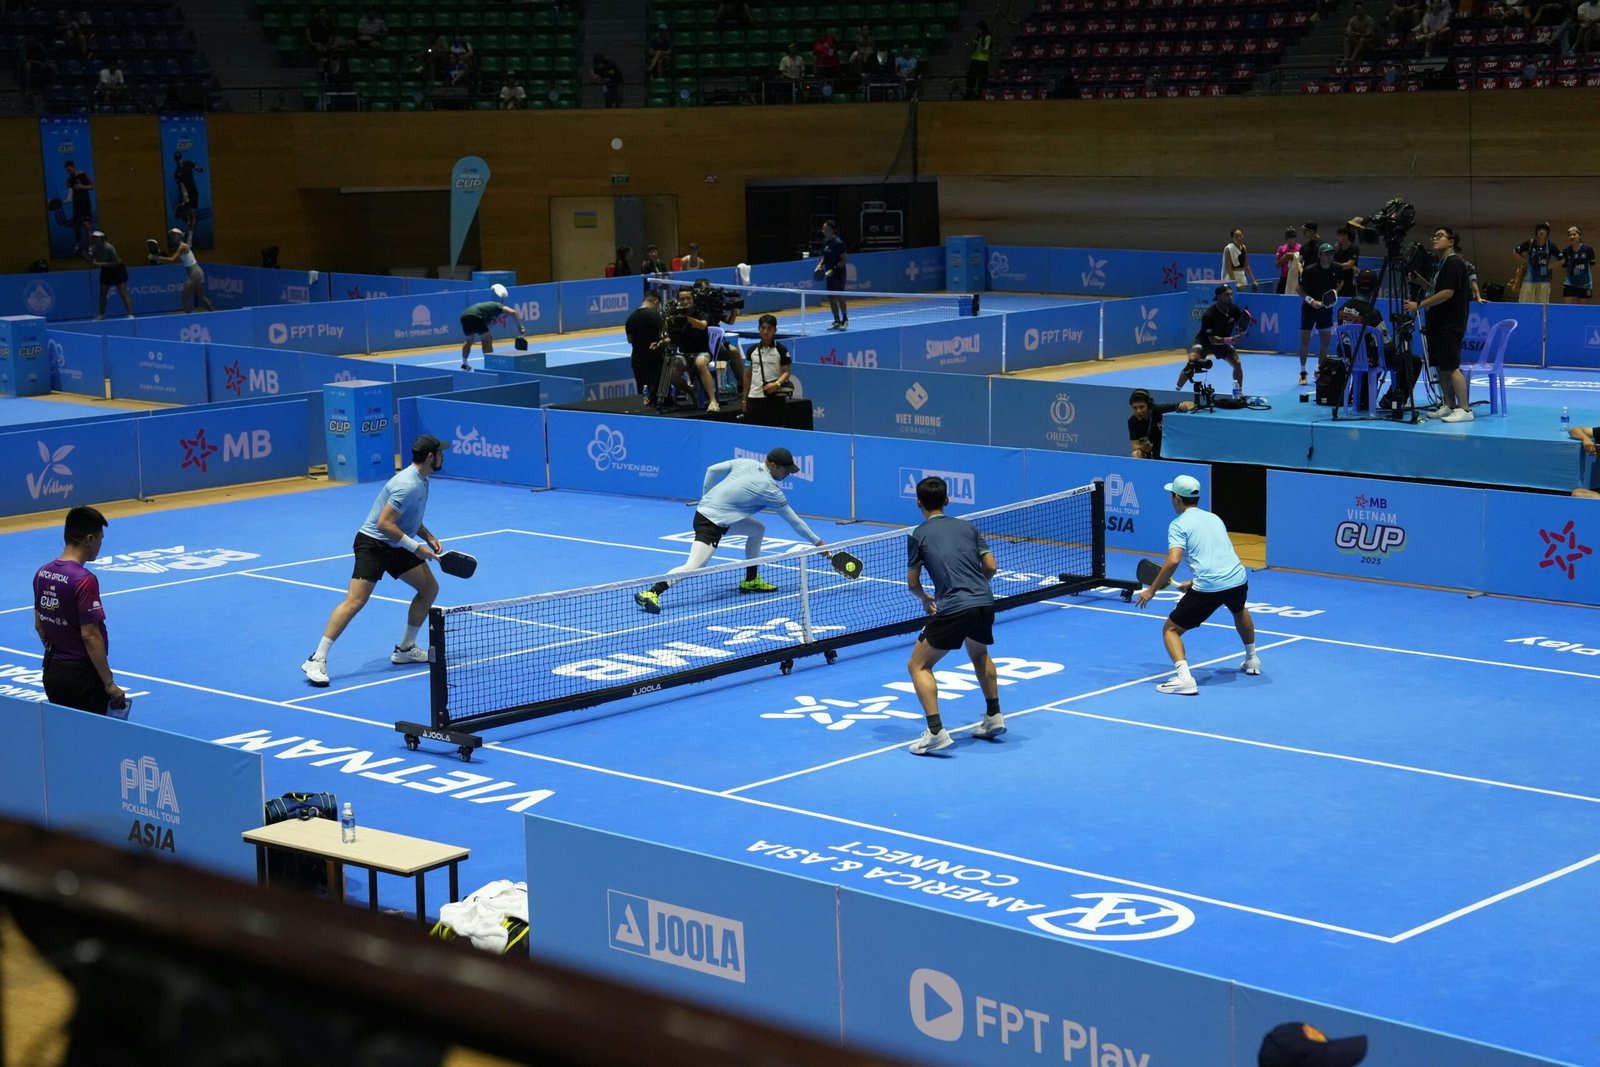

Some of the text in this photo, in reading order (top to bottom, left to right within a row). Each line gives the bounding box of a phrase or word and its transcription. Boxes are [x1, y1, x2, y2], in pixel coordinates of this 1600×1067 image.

[1386, 38, 1399, 46] VIP
[1460, 35, 1473, 43] VIP
[1486, 34, 1500, 42] VIP
[1511, 32, 1524, 40] VIP
[456, 178, 482, 190] CUP
[602, 293, 627, 311] JOOLA
[515, 301, 540, 321] MB
[291, 323, 344, 339] FPT Play
[1041, 327, 1083, 344] FPT Play
[18, 345, 43, 357] CUP
[250, 368, 280, 395] MB
[329, 420, 351, 432] CUP
[361, 418, 388, 433] CUP
[896, 413, 941, 428] VIET HUONG
[901, 426, 937, 436] CERAMICS
[1046, 431, 1079, 443] ORIENT
[223, 429, 272, 463] MB
[452, 435, 510, 460] zocker
[1092, 474, 1140, 508] PA
[1370, 497, 1388, 509] MB
[1124, 508, 1140, 516] TOUR
[1347, 509, 1397, 525] VIETNAM
[1105, 516, 1135, 534] SIA
[1335, 521, 1405, 553] CUP
[1360, 556, 1382, 565] 2025
[40, 595, 59, 608] CUP
[455, 605, 473, 614] JOOLA
[552, 641, 735, 681] MB
[883, 657, 1065, 700] MB
[638, 684, 662, 695] JOOLA
[428, 730, 451, 742] JOOLA
[210, 729, 556, 813] VIETNAM
[120, 755, 180, 815] PPA
[122, 801, 181, 825] PICKLEBALL TOUR
[127, 819, 176, 853] ASIA
[828, 841, 1020, 888] CONNECT
[746, 839, 1048, 914] AMERICA & ASIA
[655, 910, 741, 973] JOOLA
[976, 996, 1050, 1055] FPT
